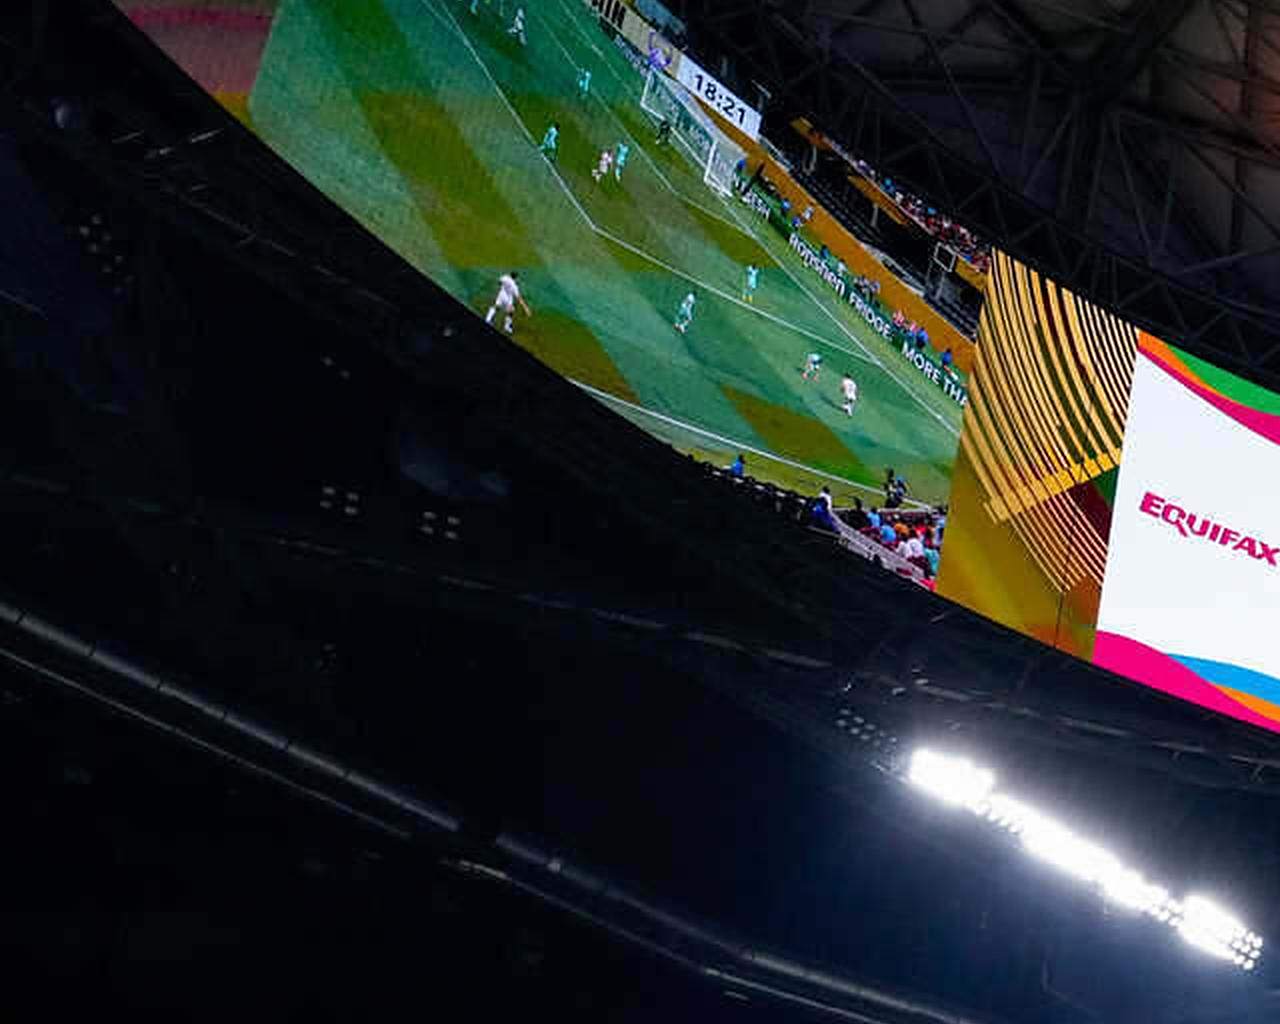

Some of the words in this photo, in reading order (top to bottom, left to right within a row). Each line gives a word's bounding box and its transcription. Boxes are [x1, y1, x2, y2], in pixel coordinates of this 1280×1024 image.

[694, 73, 747, 126] 18:21
[902, 341, 941, 385] MORE
[1139, 491, 1280, 567] EQUIFAX
